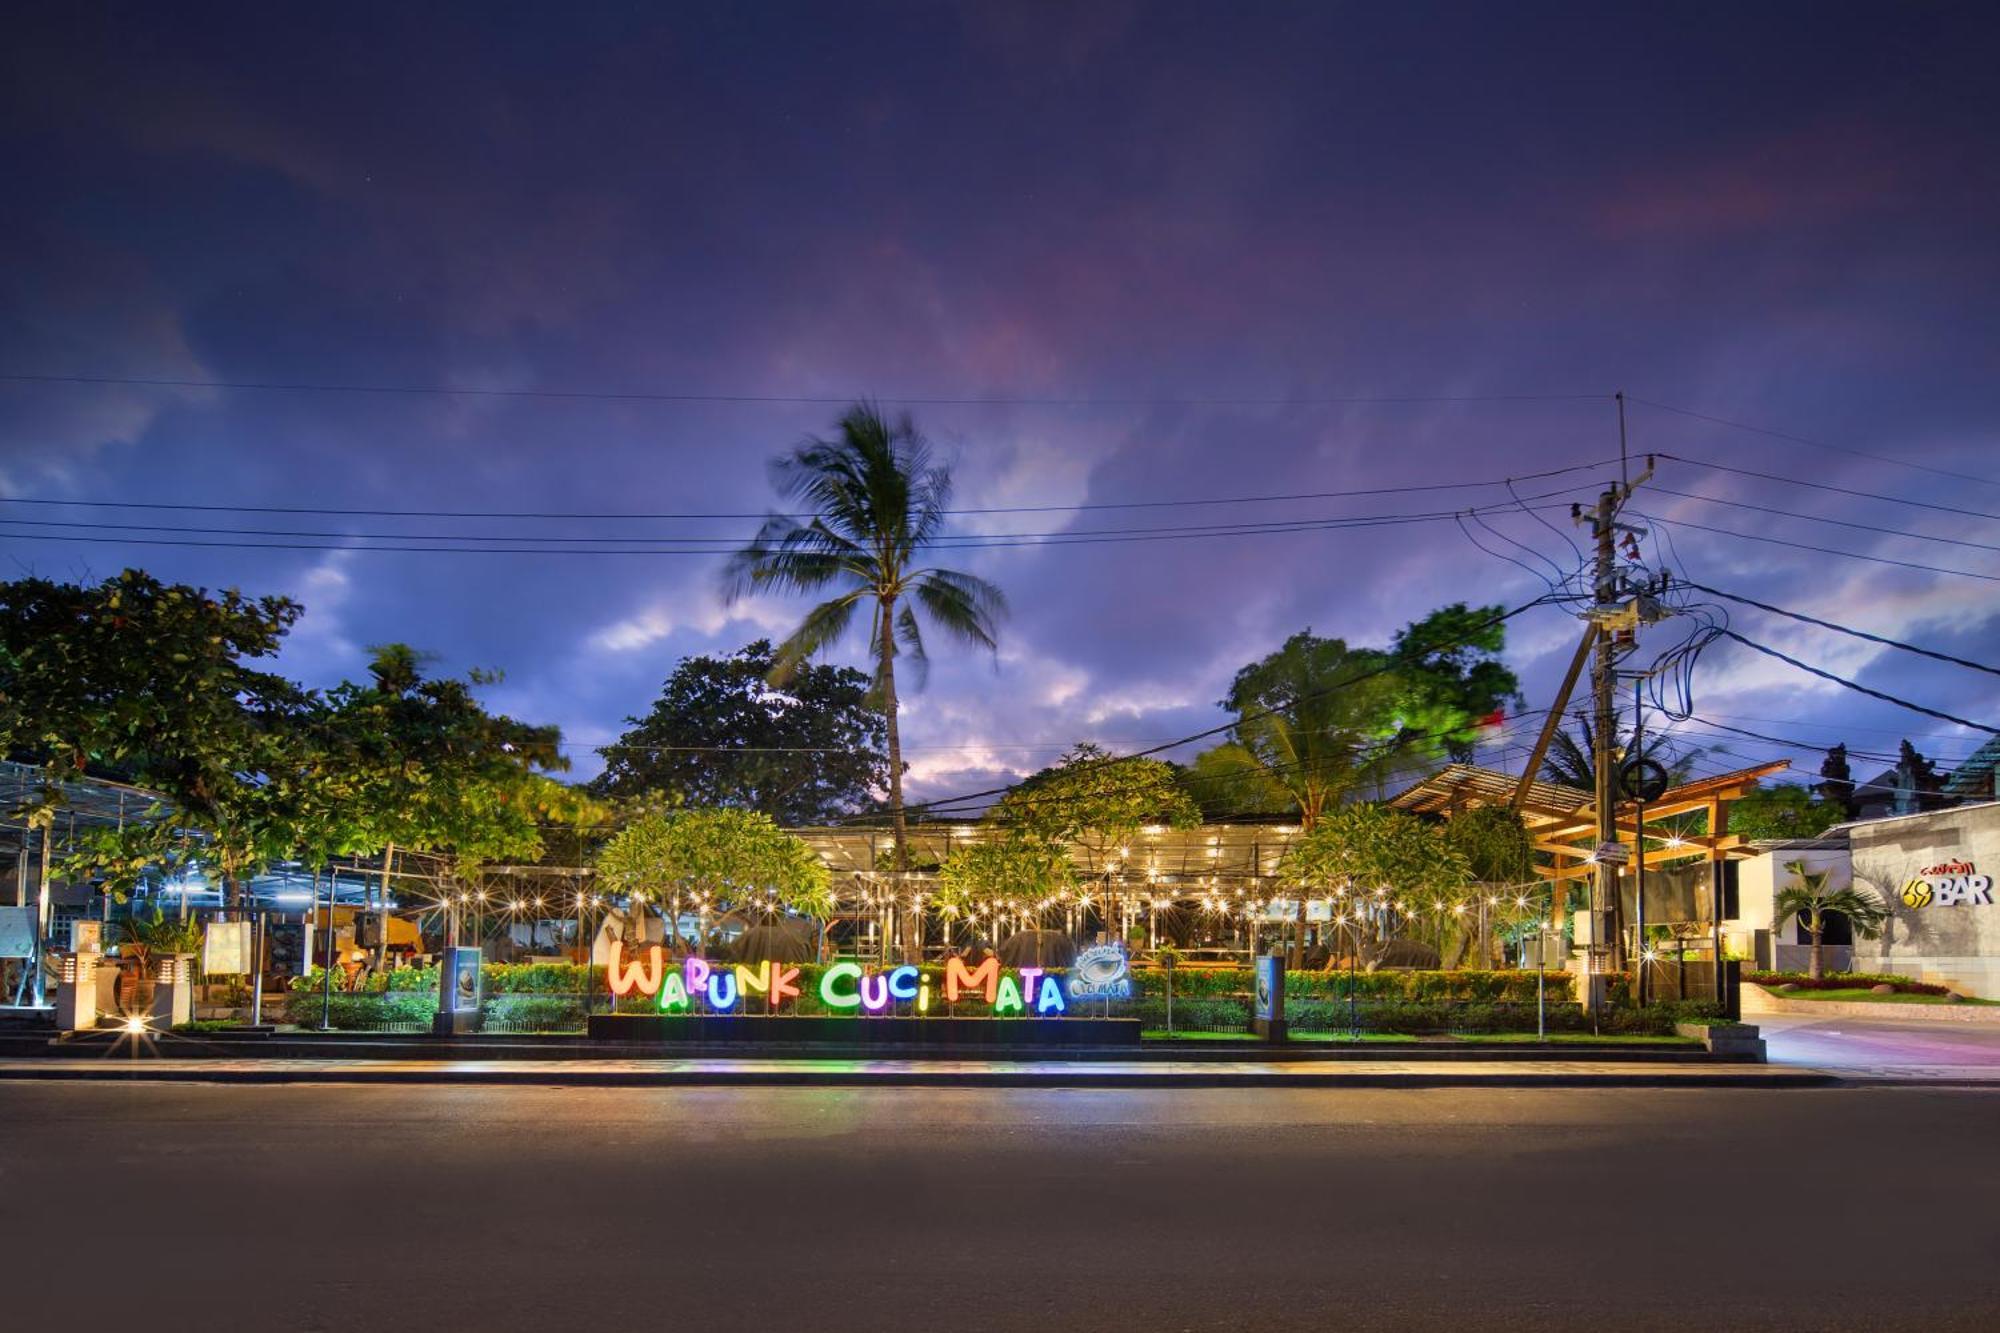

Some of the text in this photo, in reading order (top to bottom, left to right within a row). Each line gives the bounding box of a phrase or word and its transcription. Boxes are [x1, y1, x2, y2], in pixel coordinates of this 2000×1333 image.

[1936, 875, 1992, 906] BAR
[608, 940, 800, 1009] WARUNK
[946, 957, 1066, 1013] MATA
